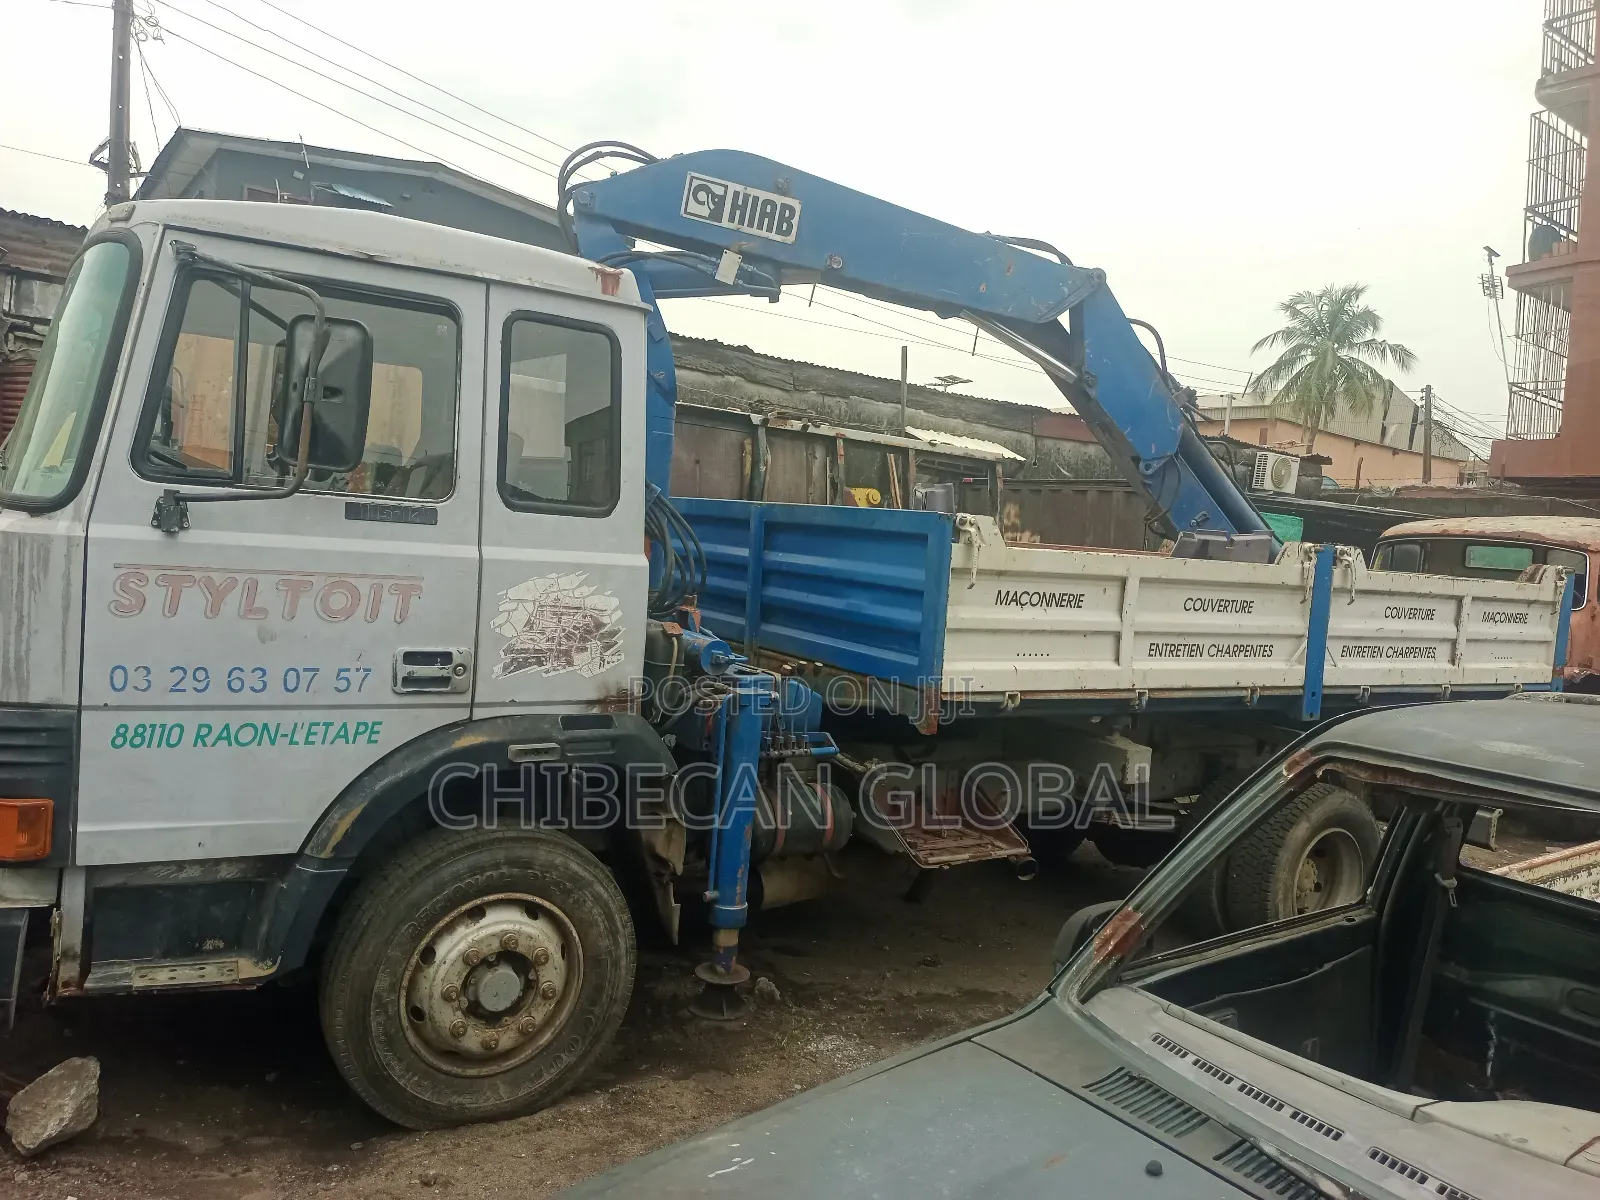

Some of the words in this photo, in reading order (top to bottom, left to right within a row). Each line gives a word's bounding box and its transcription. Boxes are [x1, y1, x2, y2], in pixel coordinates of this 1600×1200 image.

[728, 190, 796, 237] HIAB
[108, 571, 423, 624] STYLTOIT
[995, 590, 1085, 611] MAÇONNERIE
[1183, 597, 1255, 614] COUVERTURE
[1384, 606, 1436, 621] COUVERTURE
[1481, 611, 1529, 624] MAÇONNERIE
[1148, 643, 1204, 658] ENTRETIEN
[1207, 644, 1273, 658] CHARPENTES
[1340, 645, 1384, 659] ENTRETIEN
[1385, 646, 1437, 660] CHARPENTES
[109, 664, 152, 693] 03
[168, 665, 211, 694] 29
[226, 666, 267, 694] 63
[282, 666, 320, 693] 07
[333, 667, 372, 694] 57
[110, 722, 185, 750] 88110
[192, 720, 384, 748] RAON-L'ETAPE
